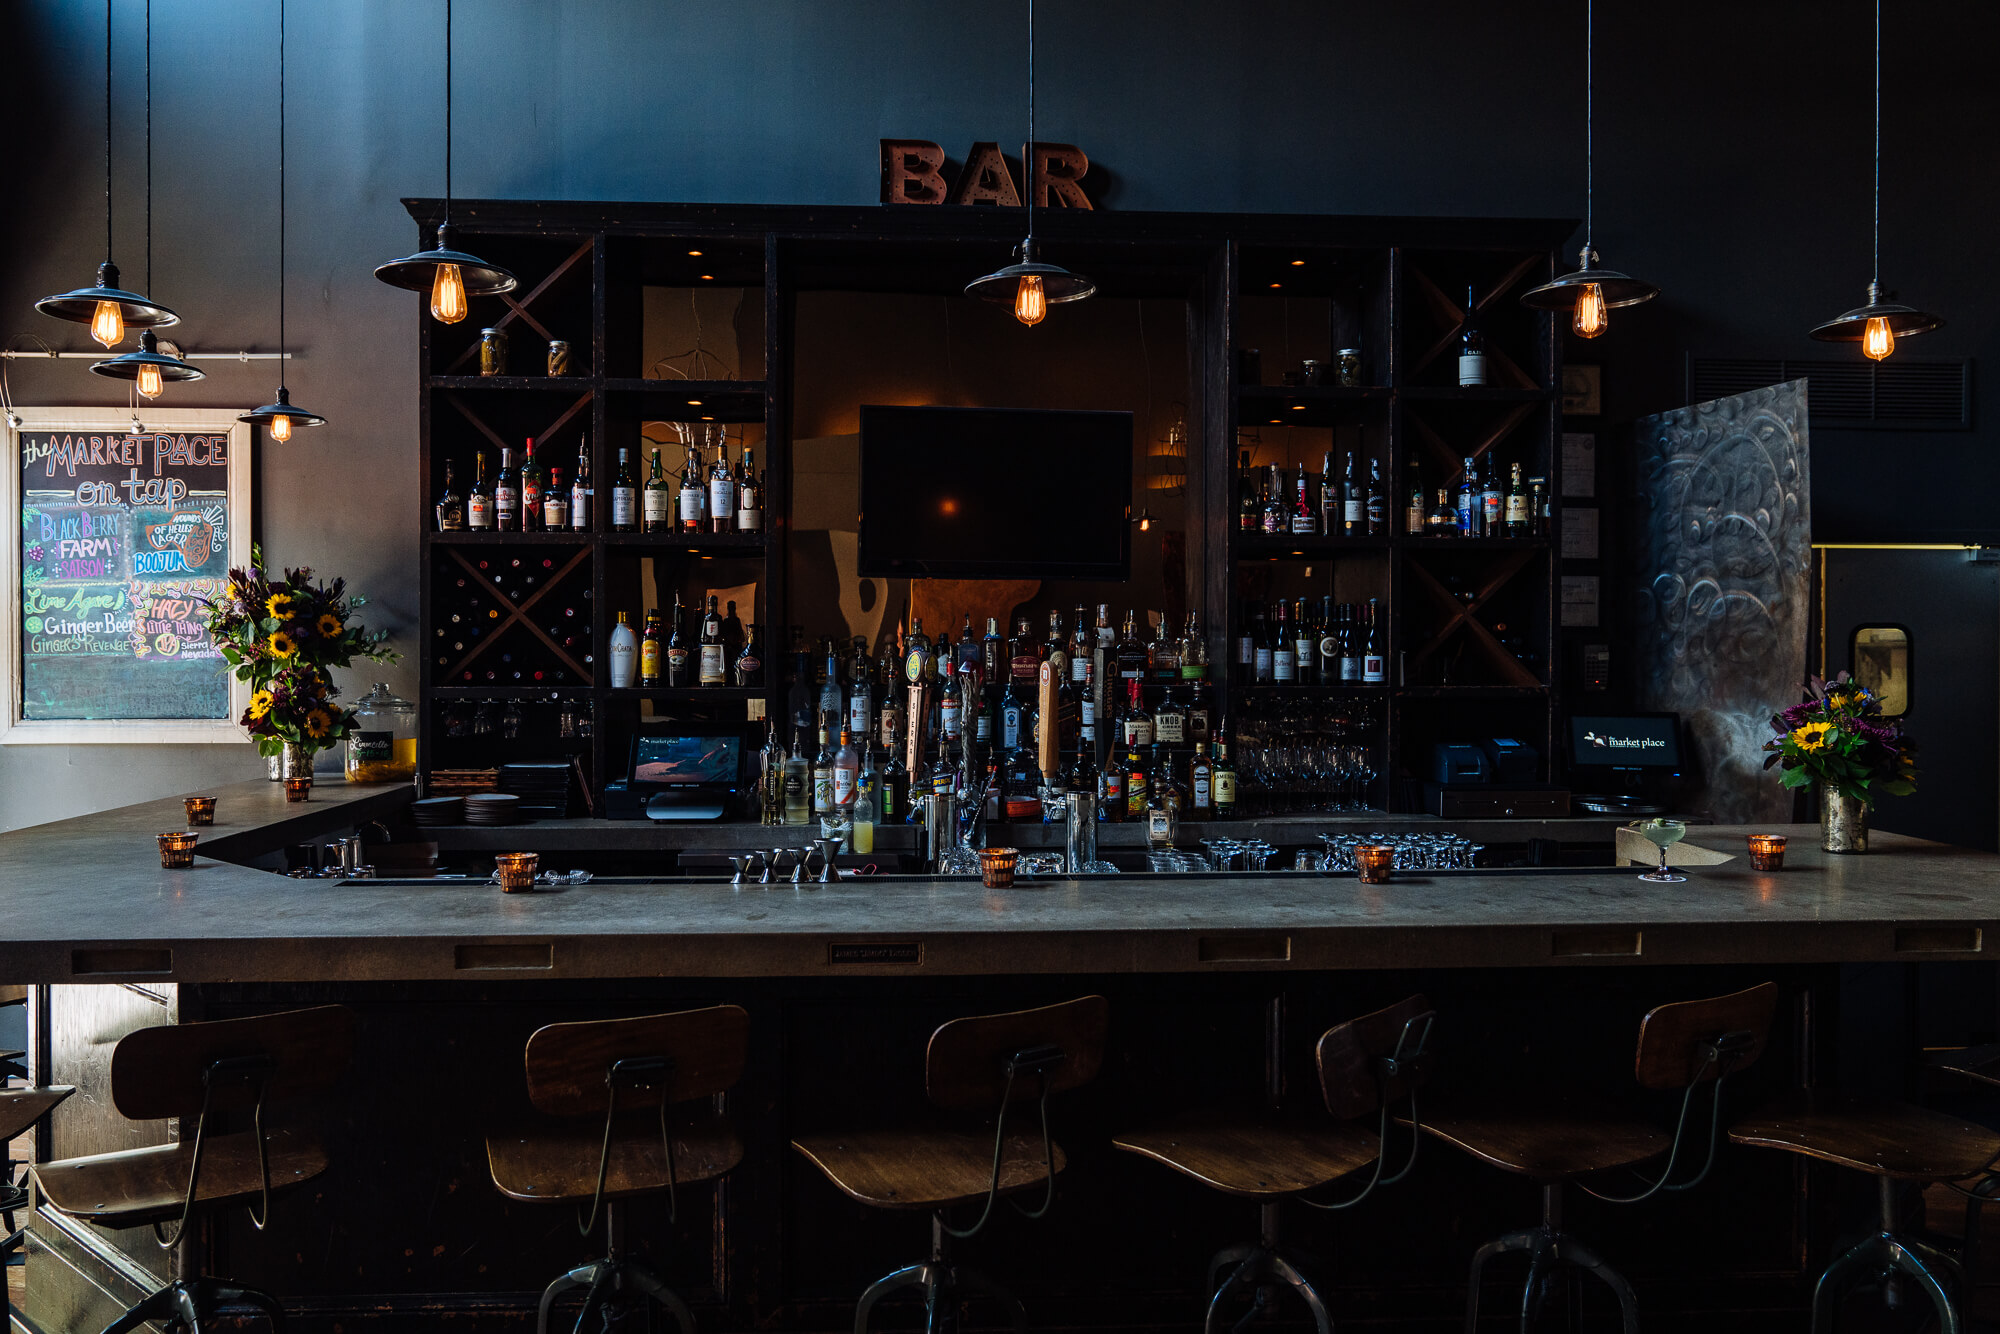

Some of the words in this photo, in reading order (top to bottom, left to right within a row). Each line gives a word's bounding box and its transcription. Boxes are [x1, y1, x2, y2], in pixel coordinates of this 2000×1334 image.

[880, 139, 1094, 211] BAR
[23, 439, 53, 469] the
[46, 434, 153, 477] MARKET
[154, 433, 227, 477] PLACE
[77, 480, 121, 506] on
[121, 468, 187, 512] tap
[154, 526, 166, 534] OF
[168, 524, 193, 533] HELLES
[60, 538, 112, 559] FARM
[151, 533, 187, 549] LAGER
[60, 558, 105, 579] SAISON
[132, 550, 195, 576] BOOJUM
[24, 588, 66, 614] Lime
[63, 587, 115, 619] Agave
[151, 599, 194, 620] HAZY
[44, 616, 104, 641] Ginger
[103, 612, 135, 633] Beer
[84, 634, 131, 653] REVENGE
[180, 641, 208, 650] Sierra
[181, 649, 215, 659] Nevada
[1160, 716, 1179, 725] KNOB
[1609, 737, 1640, 746] market
[1641, 738, 1665, 749] place
